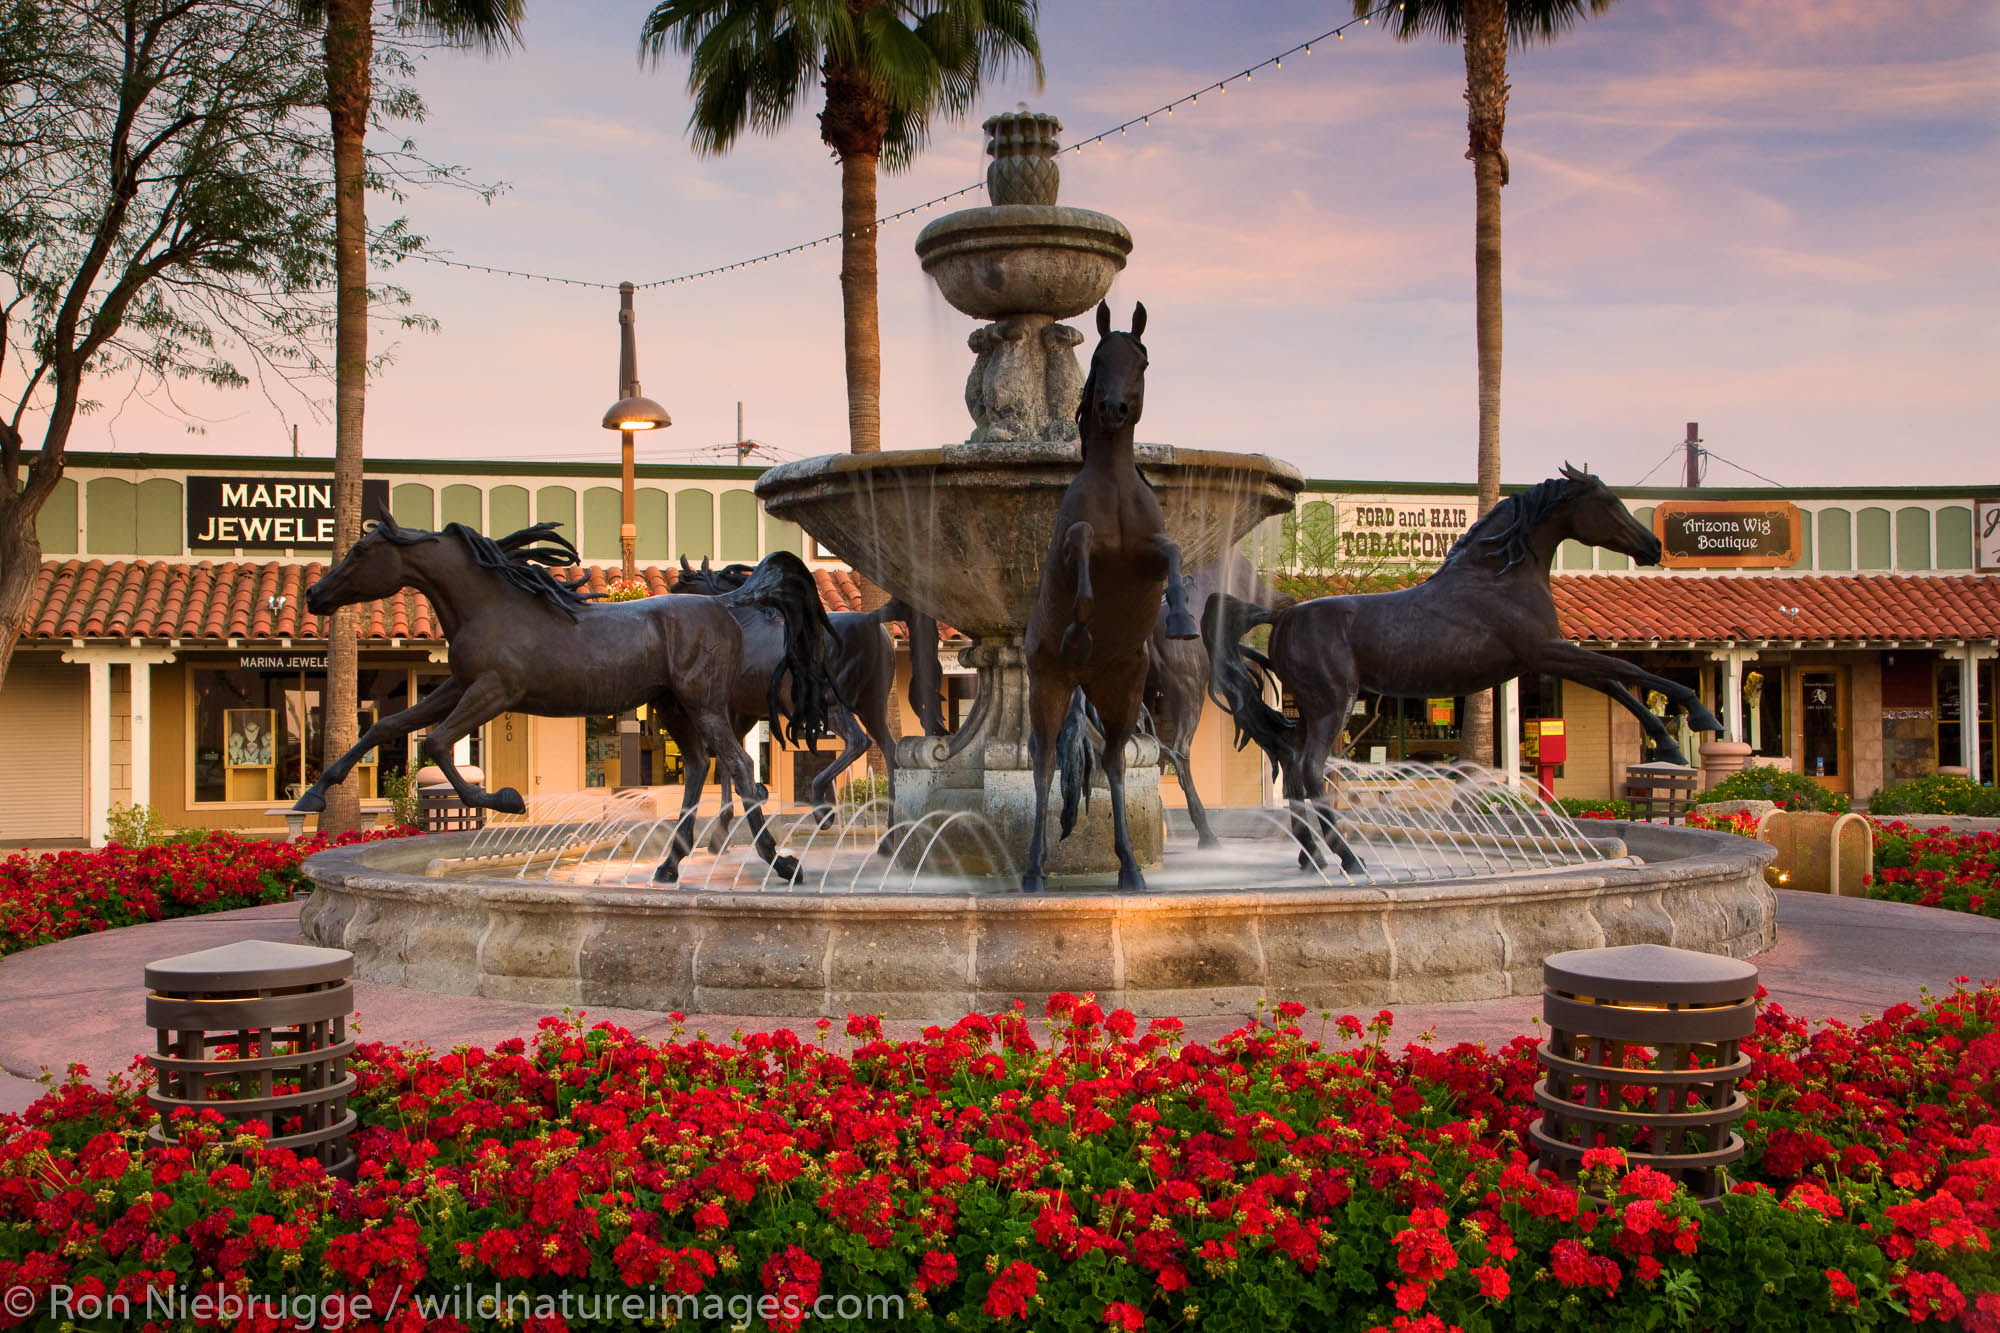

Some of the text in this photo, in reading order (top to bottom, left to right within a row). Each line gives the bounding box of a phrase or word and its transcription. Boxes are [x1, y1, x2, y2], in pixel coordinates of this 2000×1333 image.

[221, 483, 335, 509] MARIN
[1356, 507, 1467, 528] FORD and HAIG
[1683, 518, 1771, 535] Arizona Wig
[198, 517, 380, 543] JEWELES
[1342, 531, 1466, 558] TOBACCONI
[1697, 535, 1758, 551] Boutique
[240, 656, 285, 668] MARINA
